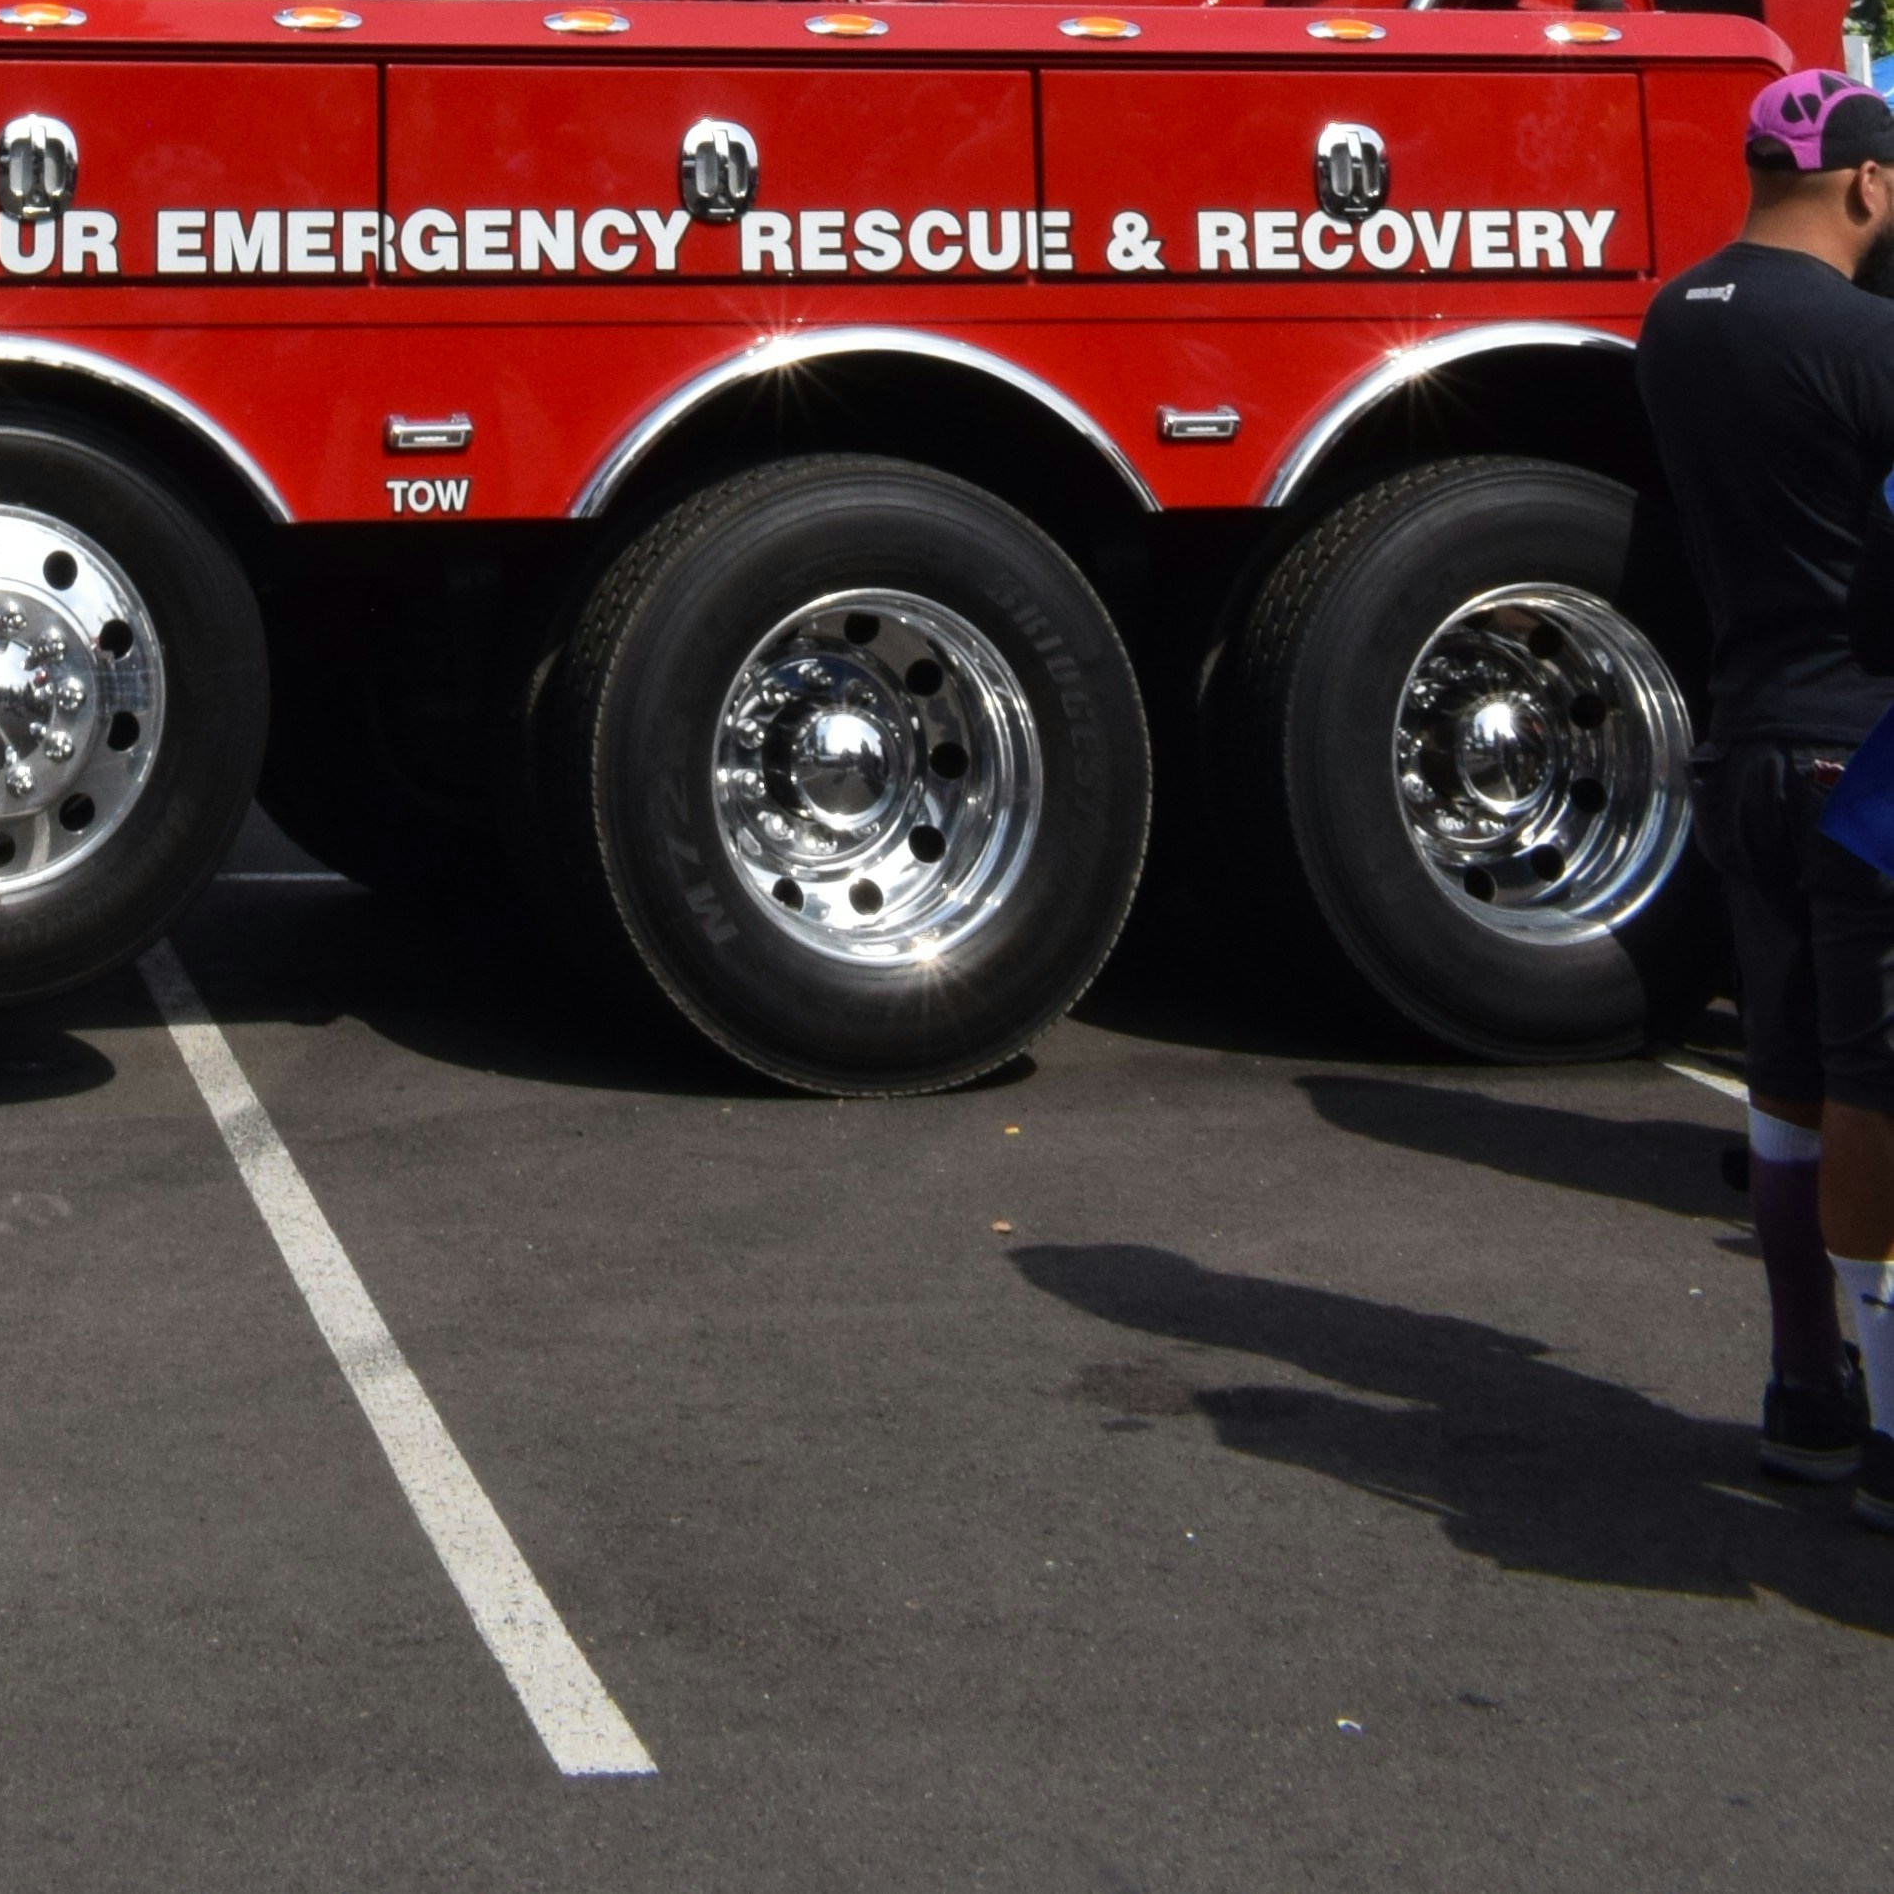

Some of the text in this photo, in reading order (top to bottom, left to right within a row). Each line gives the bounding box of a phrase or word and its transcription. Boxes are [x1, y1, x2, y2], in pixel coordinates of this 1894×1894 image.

[156, 207, 692, 274] EMERGENCY
[739, 209, 1074, 273] RESCUE
[1105, 209, 1166, 273] &
[1196, 208, 1617, 273] RECOVERY
[385, 479, 470, 513] TOW
